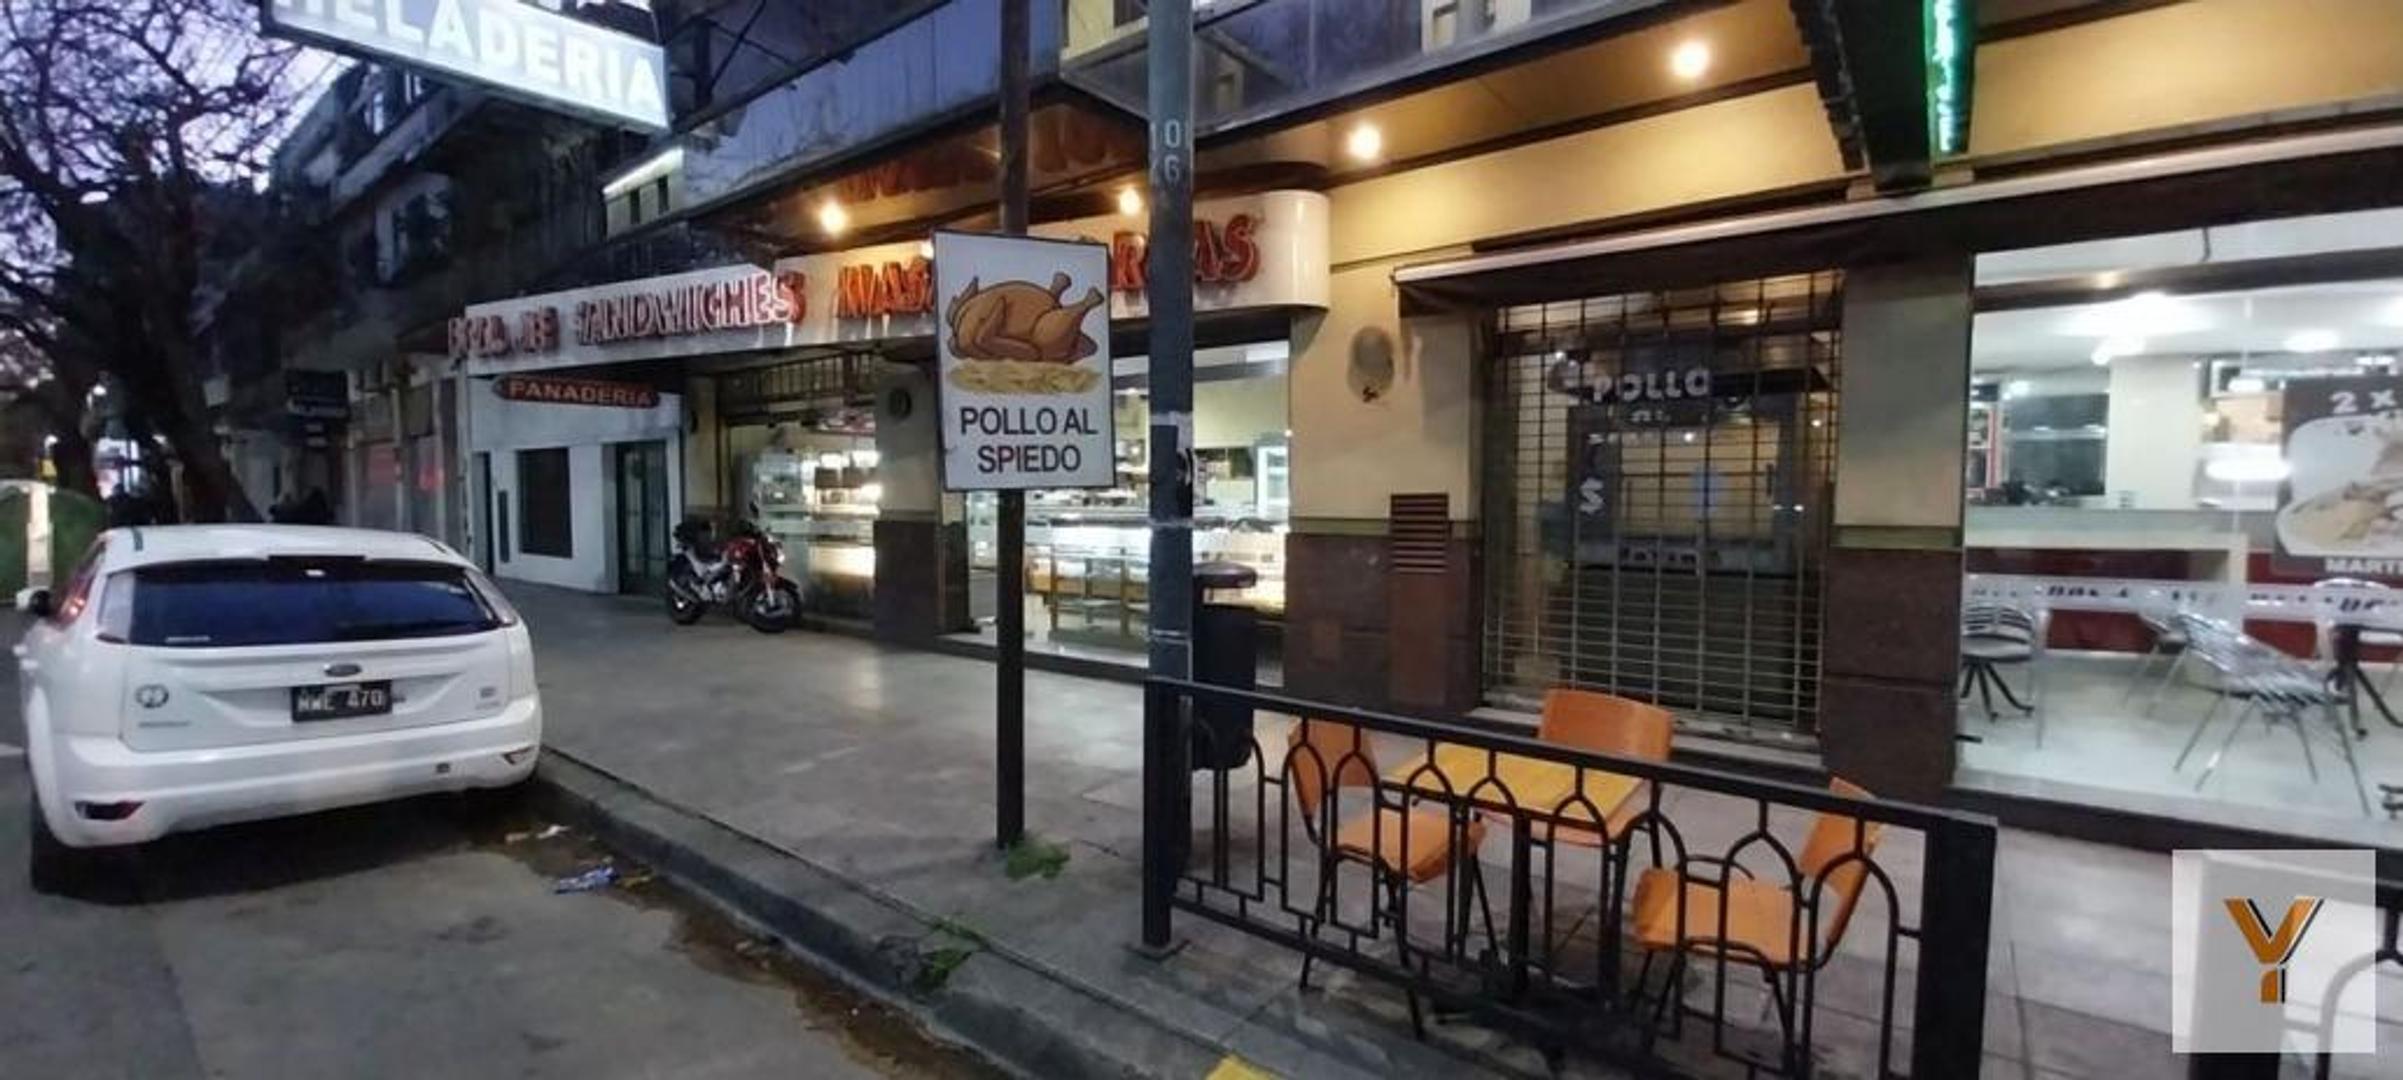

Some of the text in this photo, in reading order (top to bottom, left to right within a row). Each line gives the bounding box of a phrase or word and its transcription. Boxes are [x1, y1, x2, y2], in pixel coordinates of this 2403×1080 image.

[575, 270, 806, 345] SANDWICHES
[509, 378, 653, 406] PANADERIA
[2329, 391, 2358, 413] 2
[960, 406, 1099, 436] POLLO AL
[977, 444, 1082, 474] SPIEDO
[346, 687, 384, 709] 470
